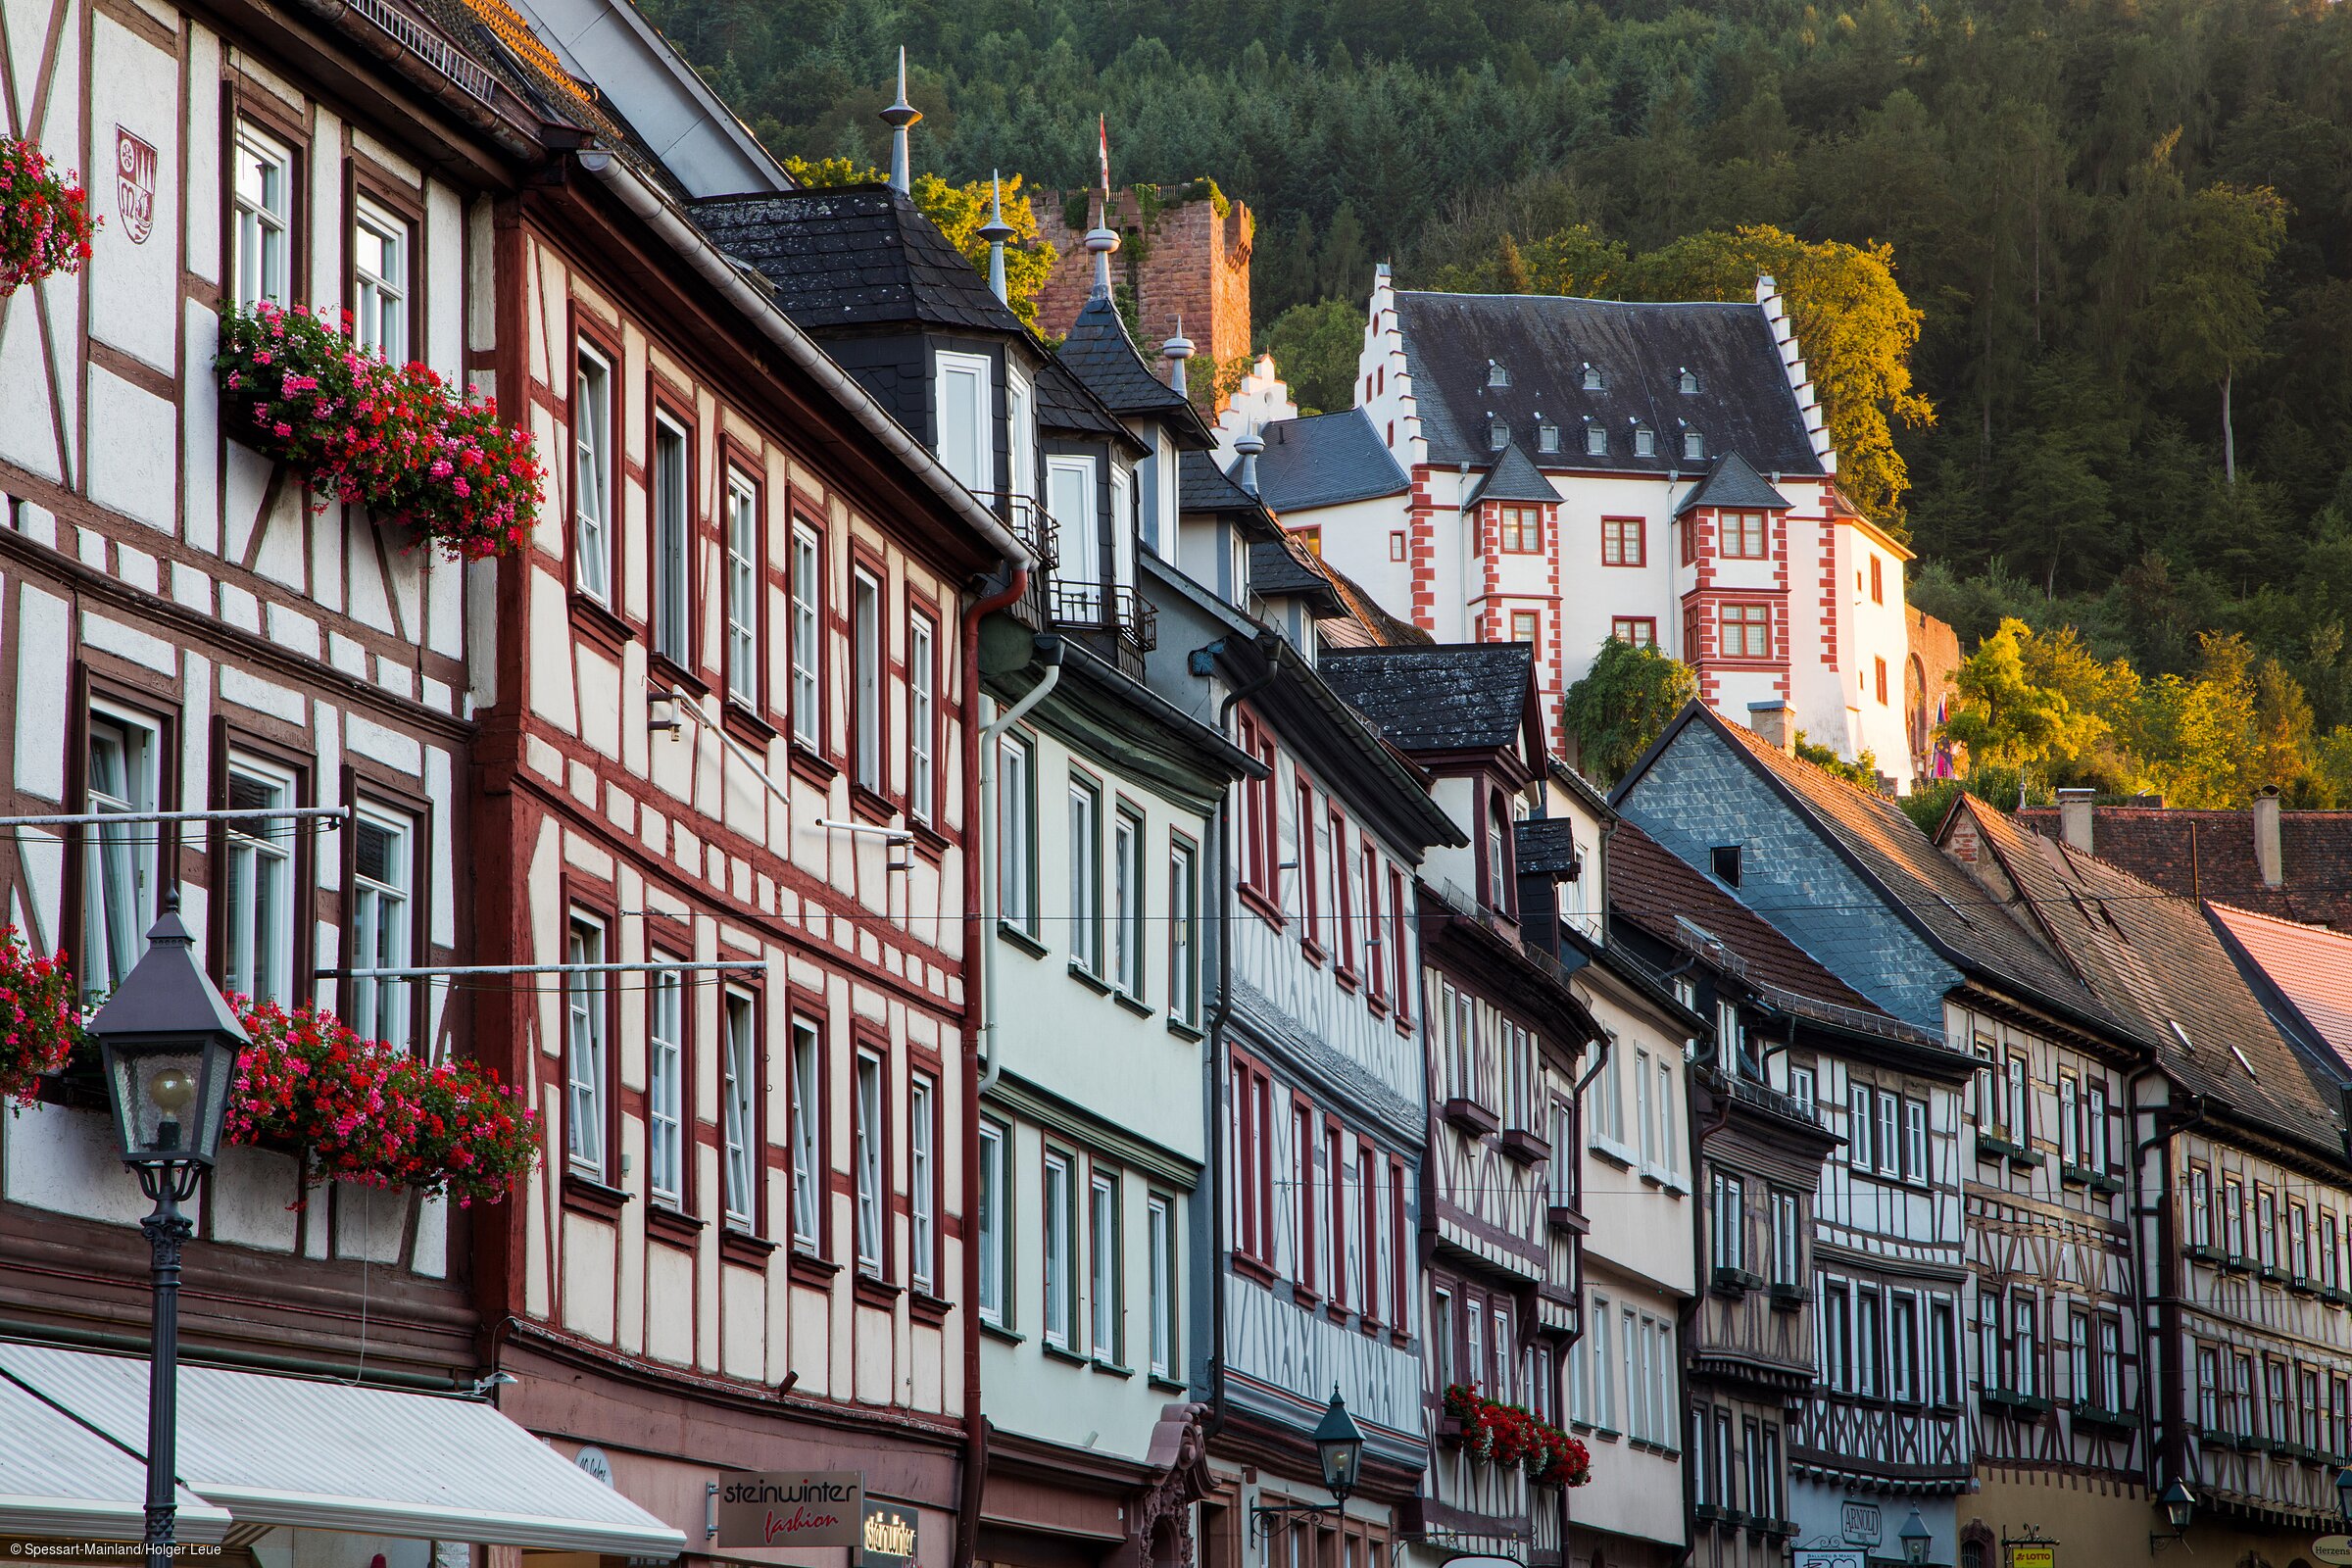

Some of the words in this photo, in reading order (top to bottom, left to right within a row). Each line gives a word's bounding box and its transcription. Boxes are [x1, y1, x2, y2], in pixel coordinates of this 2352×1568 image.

[723, 1478, 858, 1503] steinwinter
[764, 1505, 839, 1544] fashion
[864, 1511, 916, 1557] steinwinter
[1844, 1507, 1879, 1536] ARNOLD
[2315, 1546, 2351, 1555] Herzens
